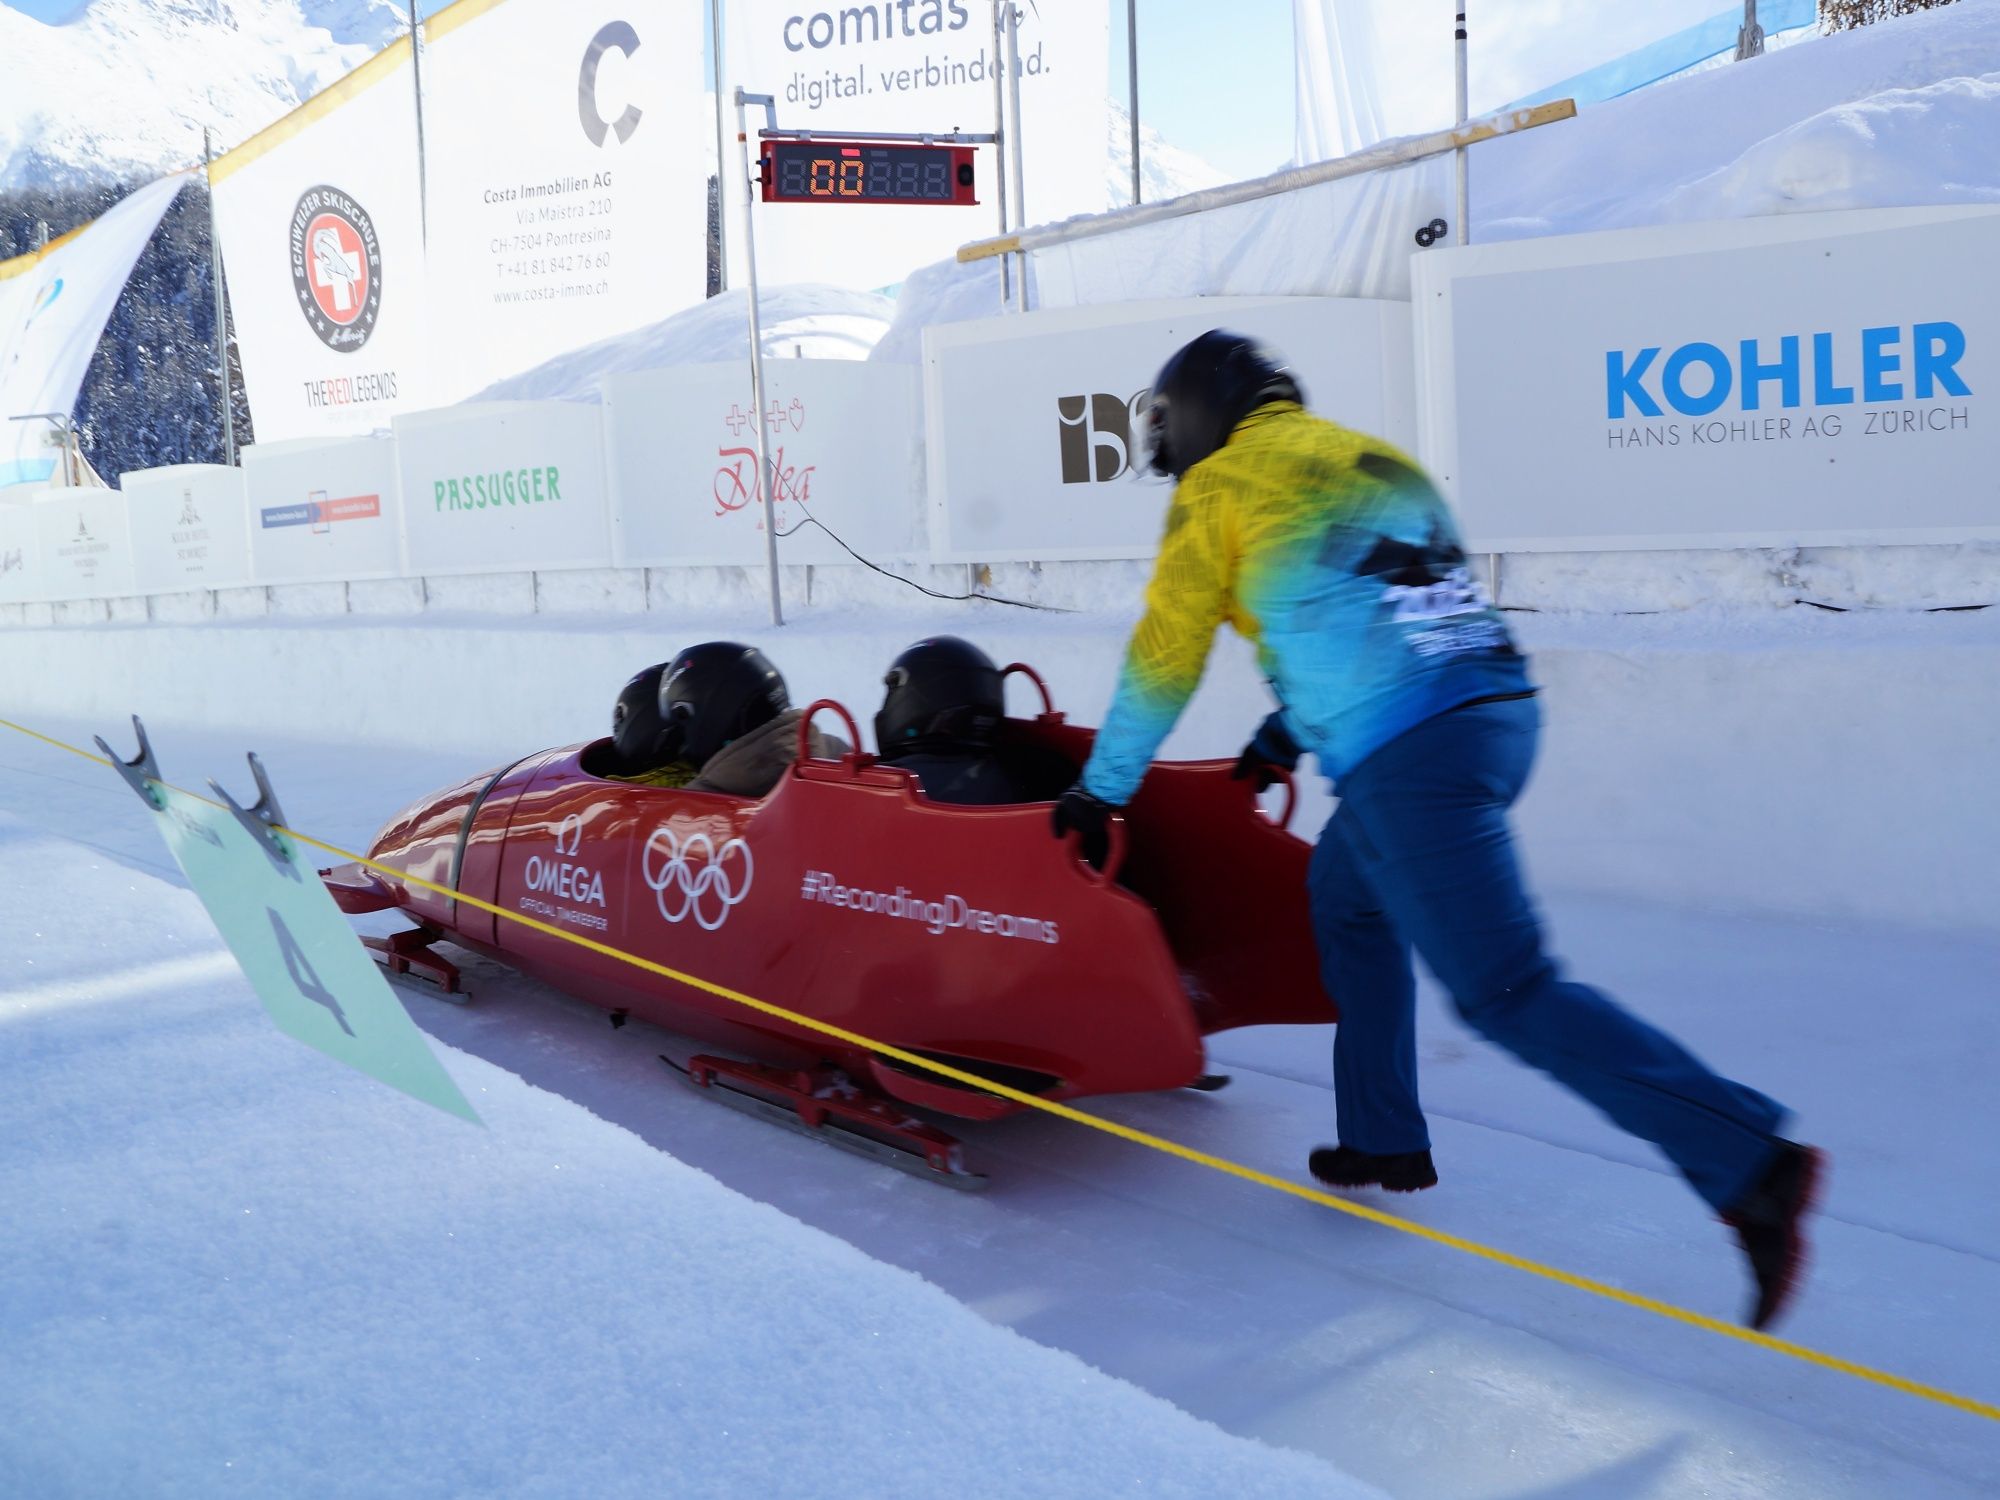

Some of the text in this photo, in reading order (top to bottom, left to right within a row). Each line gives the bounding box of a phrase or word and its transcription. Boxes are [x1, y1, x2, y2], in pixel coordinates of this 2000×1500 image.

[783, 0, 969, 53] comitas
[786, 63, 873, 111] digital.
[484, 171, 612, 204] Costa Immobilien AG
[292, 190, 380, 279] SCHWEIZER SKISCHULE
[516, 198, 612, 225] Via Maistra 210
[546, 226, 611, 248] Pontresina
[496, 263, 504, 279] T
[531, 259, 546, 275] 81
[550, 256, 573, 273] 842
[577, 254, 592, 270] 76
[595, 251, 610, 268] 60
[493, 279, 609, 304] www.costa-immo.ch
[1606, 320, 1974, 420] KOHLER
[1607, 406, 1969, 449] HANS KOHLER AG ZÜRICH
[433, 465, 562, 512] PASSUGGER
[525, 855, 607, 908] OMEGA
[801, 869, 1060, 945] #RecordingDreams
